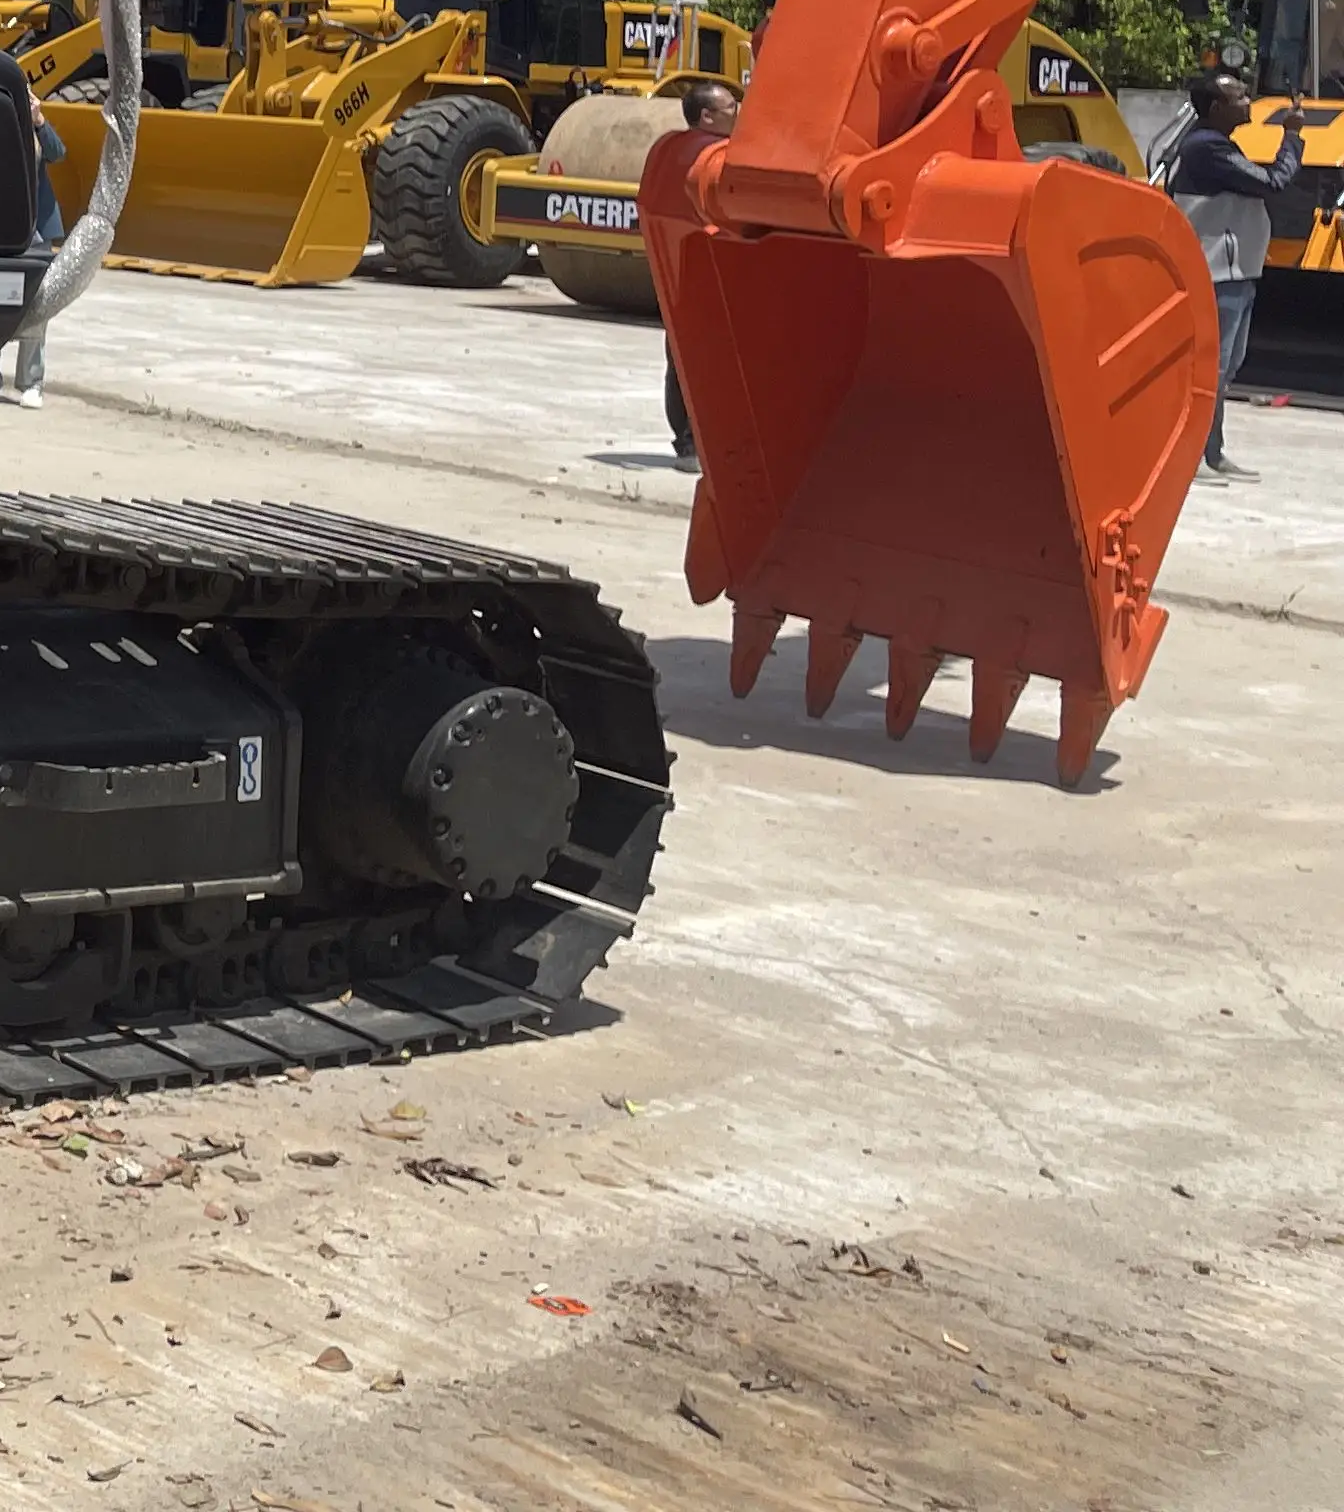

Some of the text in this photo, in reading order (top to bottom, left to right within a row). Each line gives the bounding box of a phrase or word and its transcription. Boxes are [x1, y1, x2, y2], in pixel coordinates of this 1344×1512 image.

[624, 21, 653, 49] CAT
[1038, 57, 1071, 94] CAT
[334, 81, 370, 126] 966H
